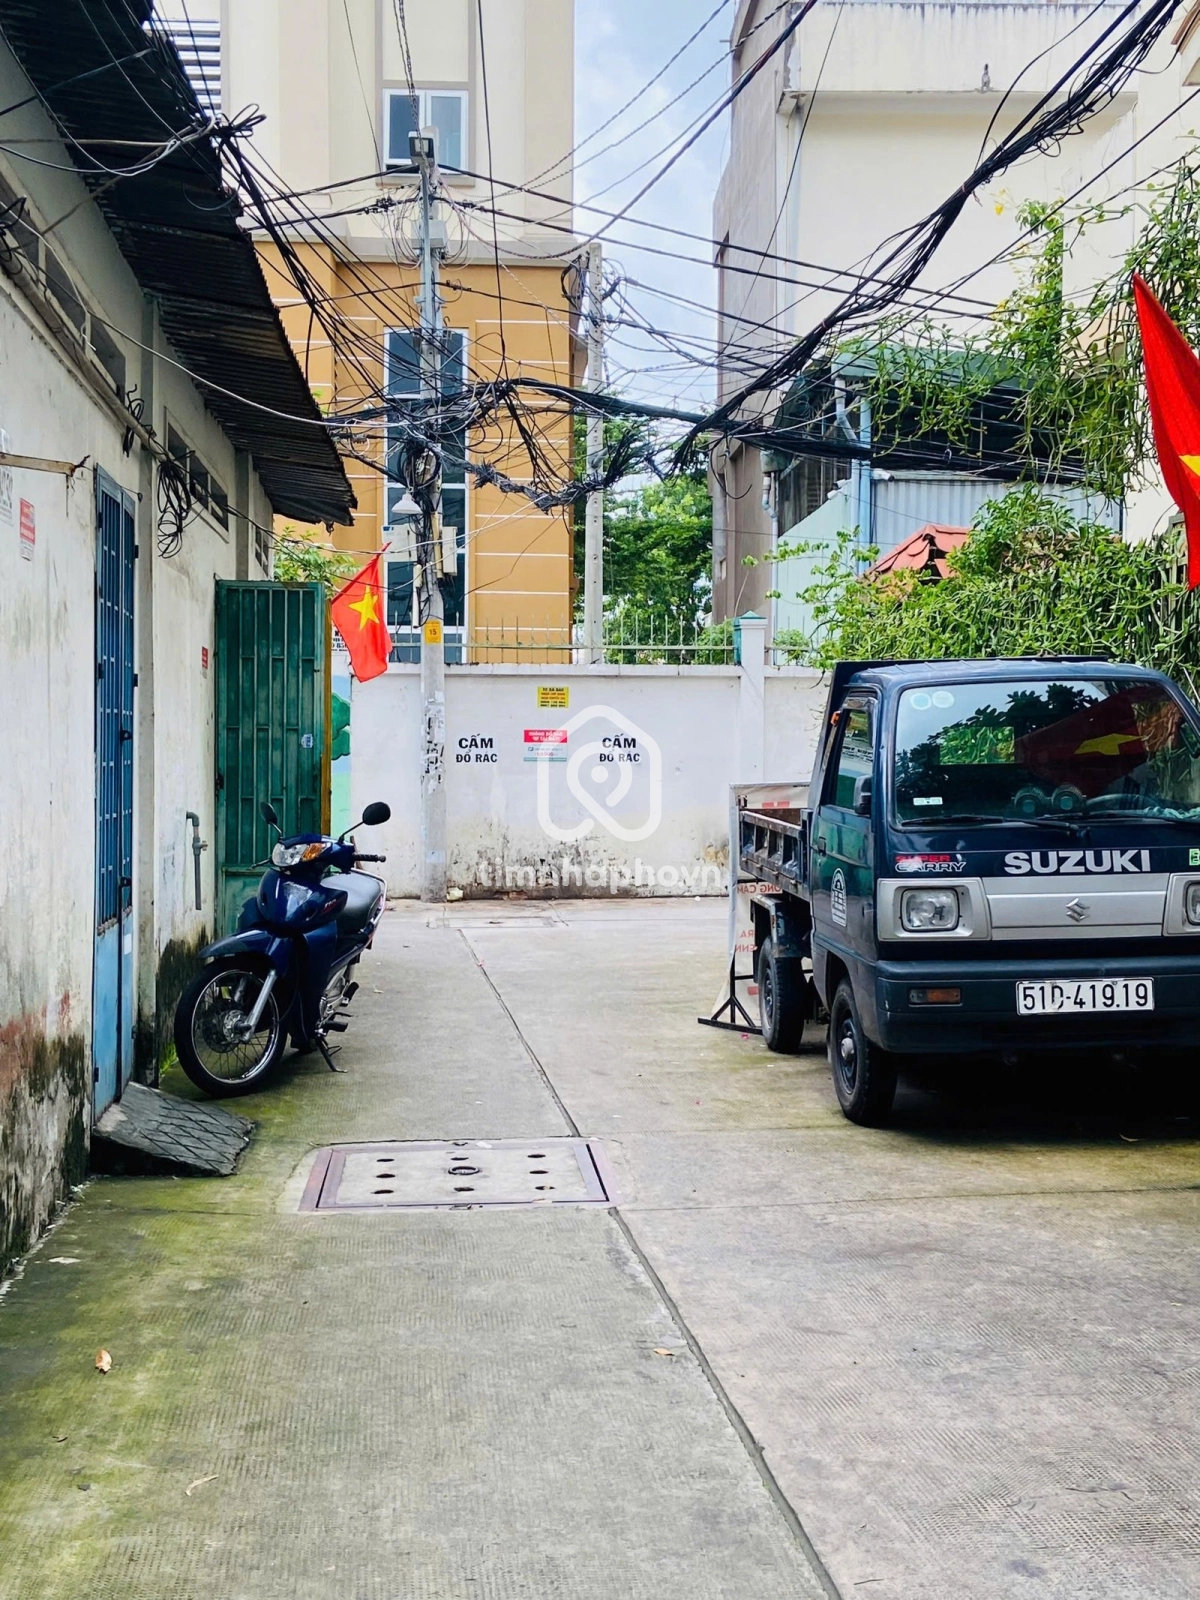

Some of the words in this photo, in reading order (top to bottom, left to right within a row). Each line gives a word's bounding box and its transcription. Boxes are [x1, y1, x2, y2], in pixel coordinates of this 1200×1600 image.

[458, 733, 493, 749] CẤM
[602, 733, 637, 749] CẤM
[475, 751, 498, 763] RÁC
[895, 861, 967, 873] CARRY
[1004, 849, 1151, 875] SUZUKI
